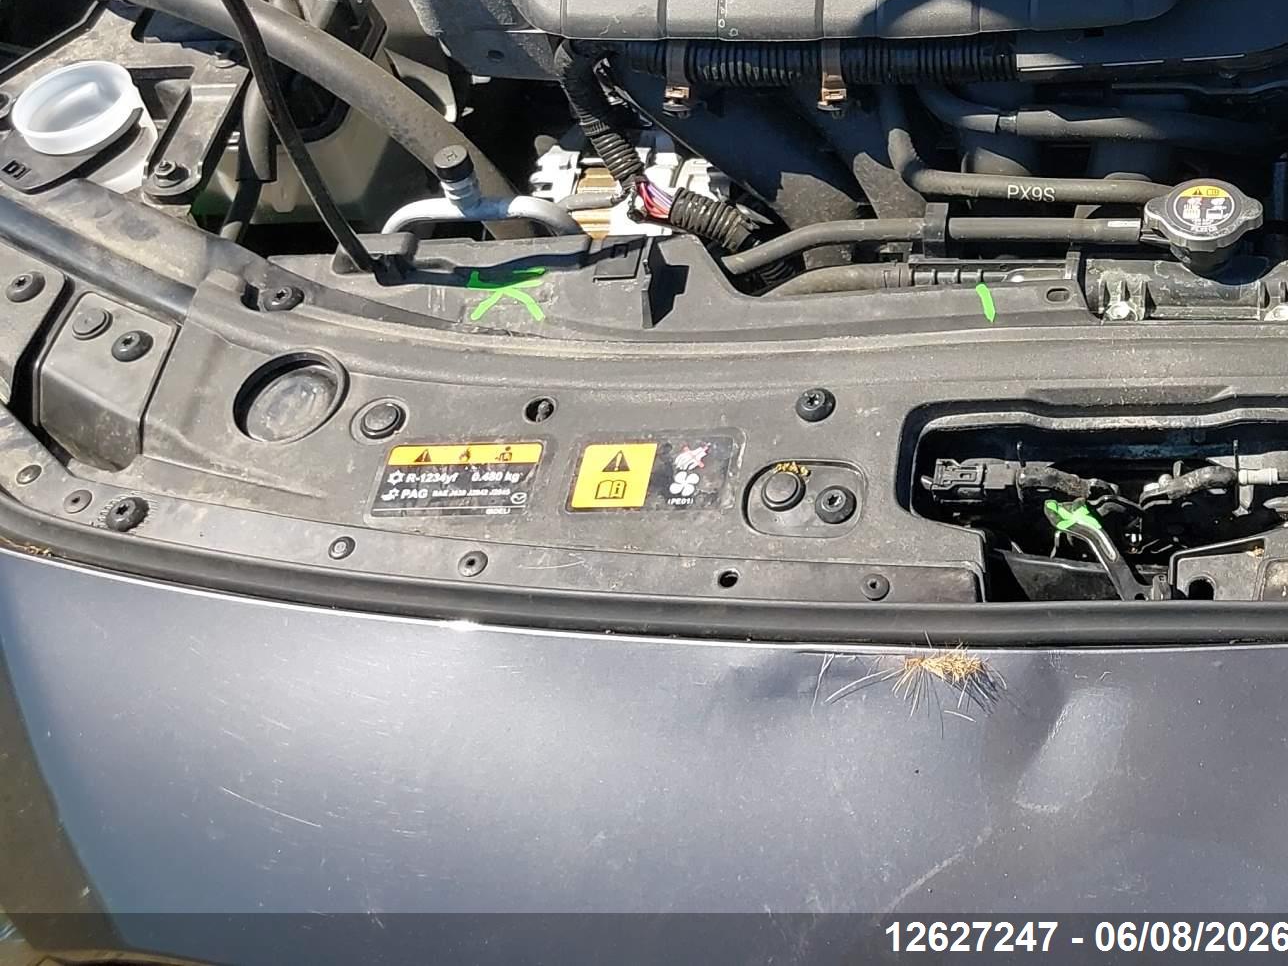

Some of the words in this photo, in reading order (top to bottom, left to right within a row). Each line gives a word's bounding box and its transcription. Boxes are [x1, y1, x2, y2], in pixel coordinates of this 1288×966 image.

[1007, 184, 1056, 202] PX9S
[405, 472, 459, 484] R-1234yf
[472, 471, 503, 482] 0.480
[504, 471, 521, 484] kg
[400, 488, 428, 499] PAG
